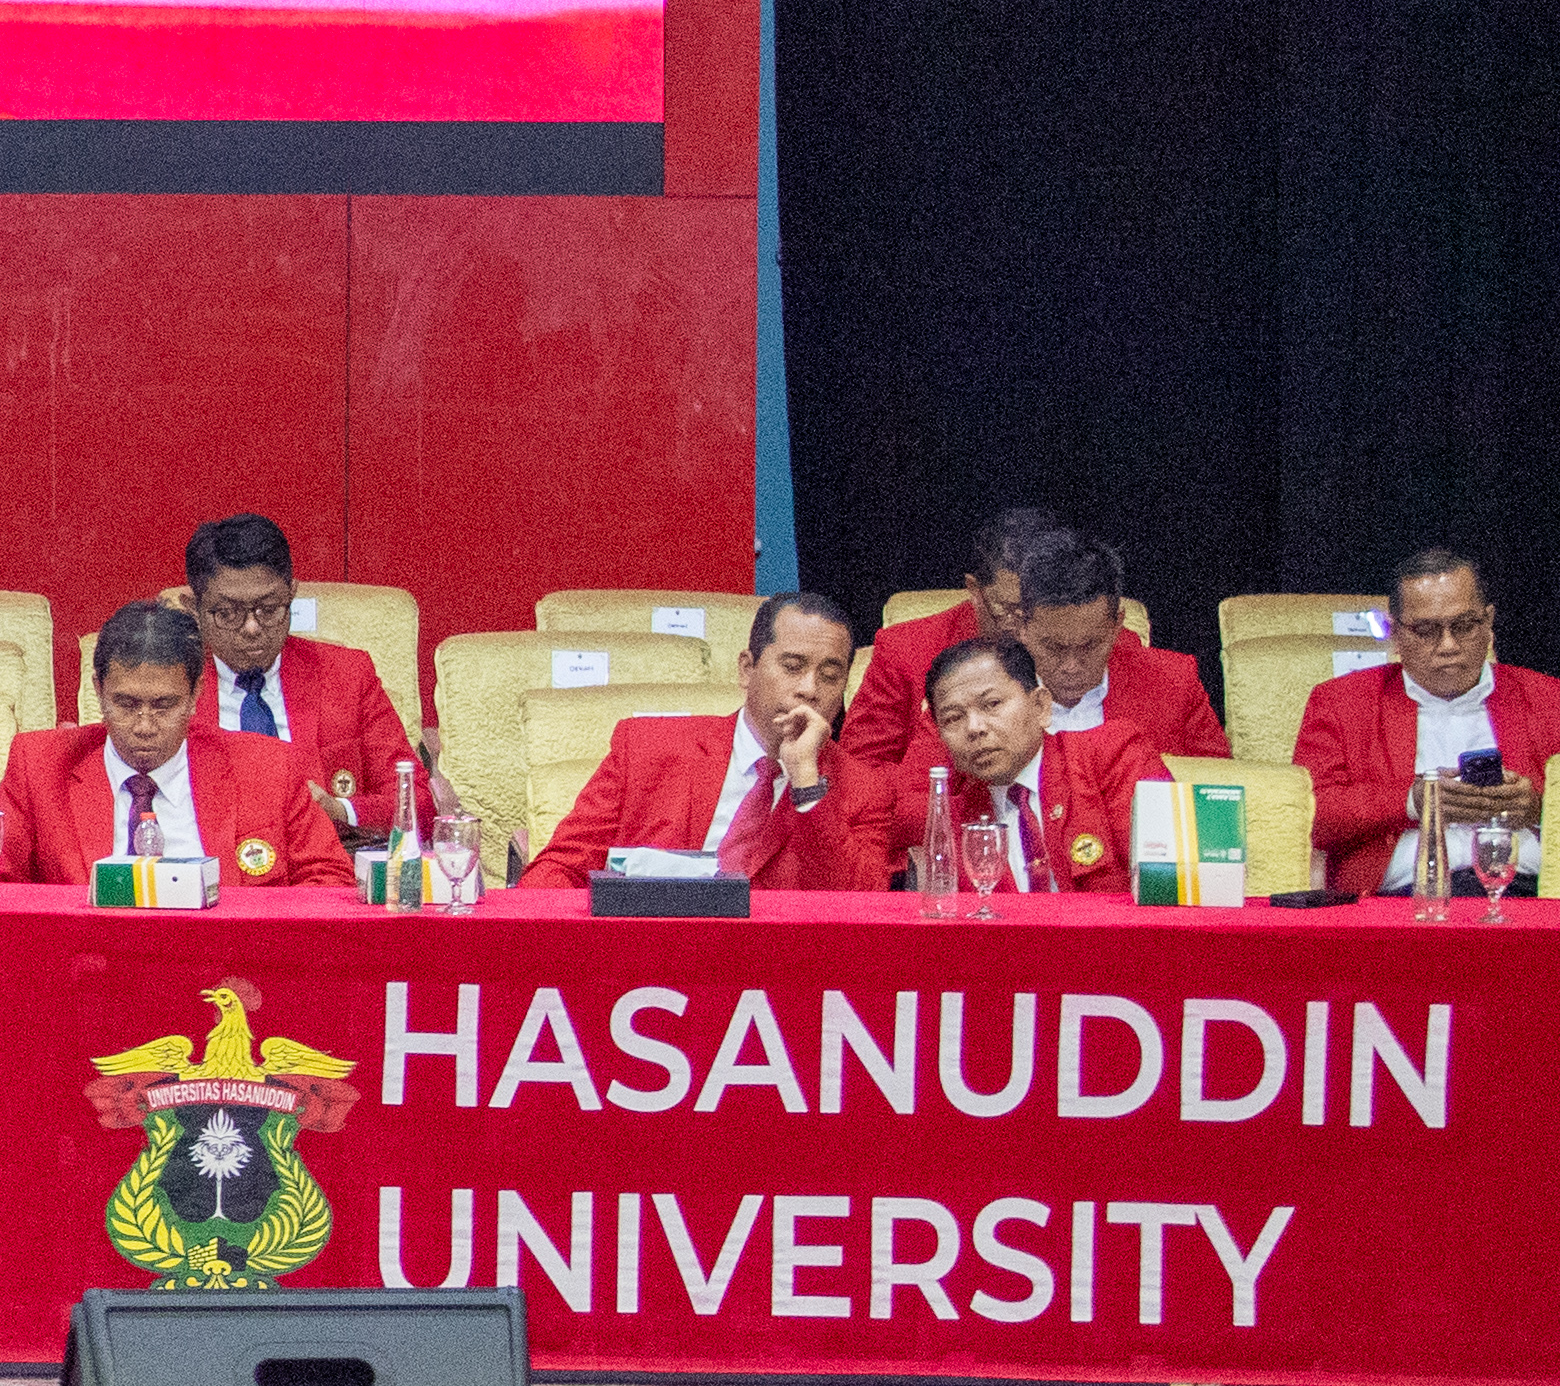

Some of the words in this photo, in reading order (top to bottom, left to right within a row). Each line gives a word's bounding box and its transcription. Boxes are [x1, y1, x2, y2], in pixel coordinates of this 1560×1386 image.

[147, 1082, 220, 1108] UNIVERSITAS
[221, 1083, 296, 1111] HASANUDDIN
[383, 983, 1450, 1127] HASANUDDIN
[380, 1187, 1294, 1325] UNIVERSITY
